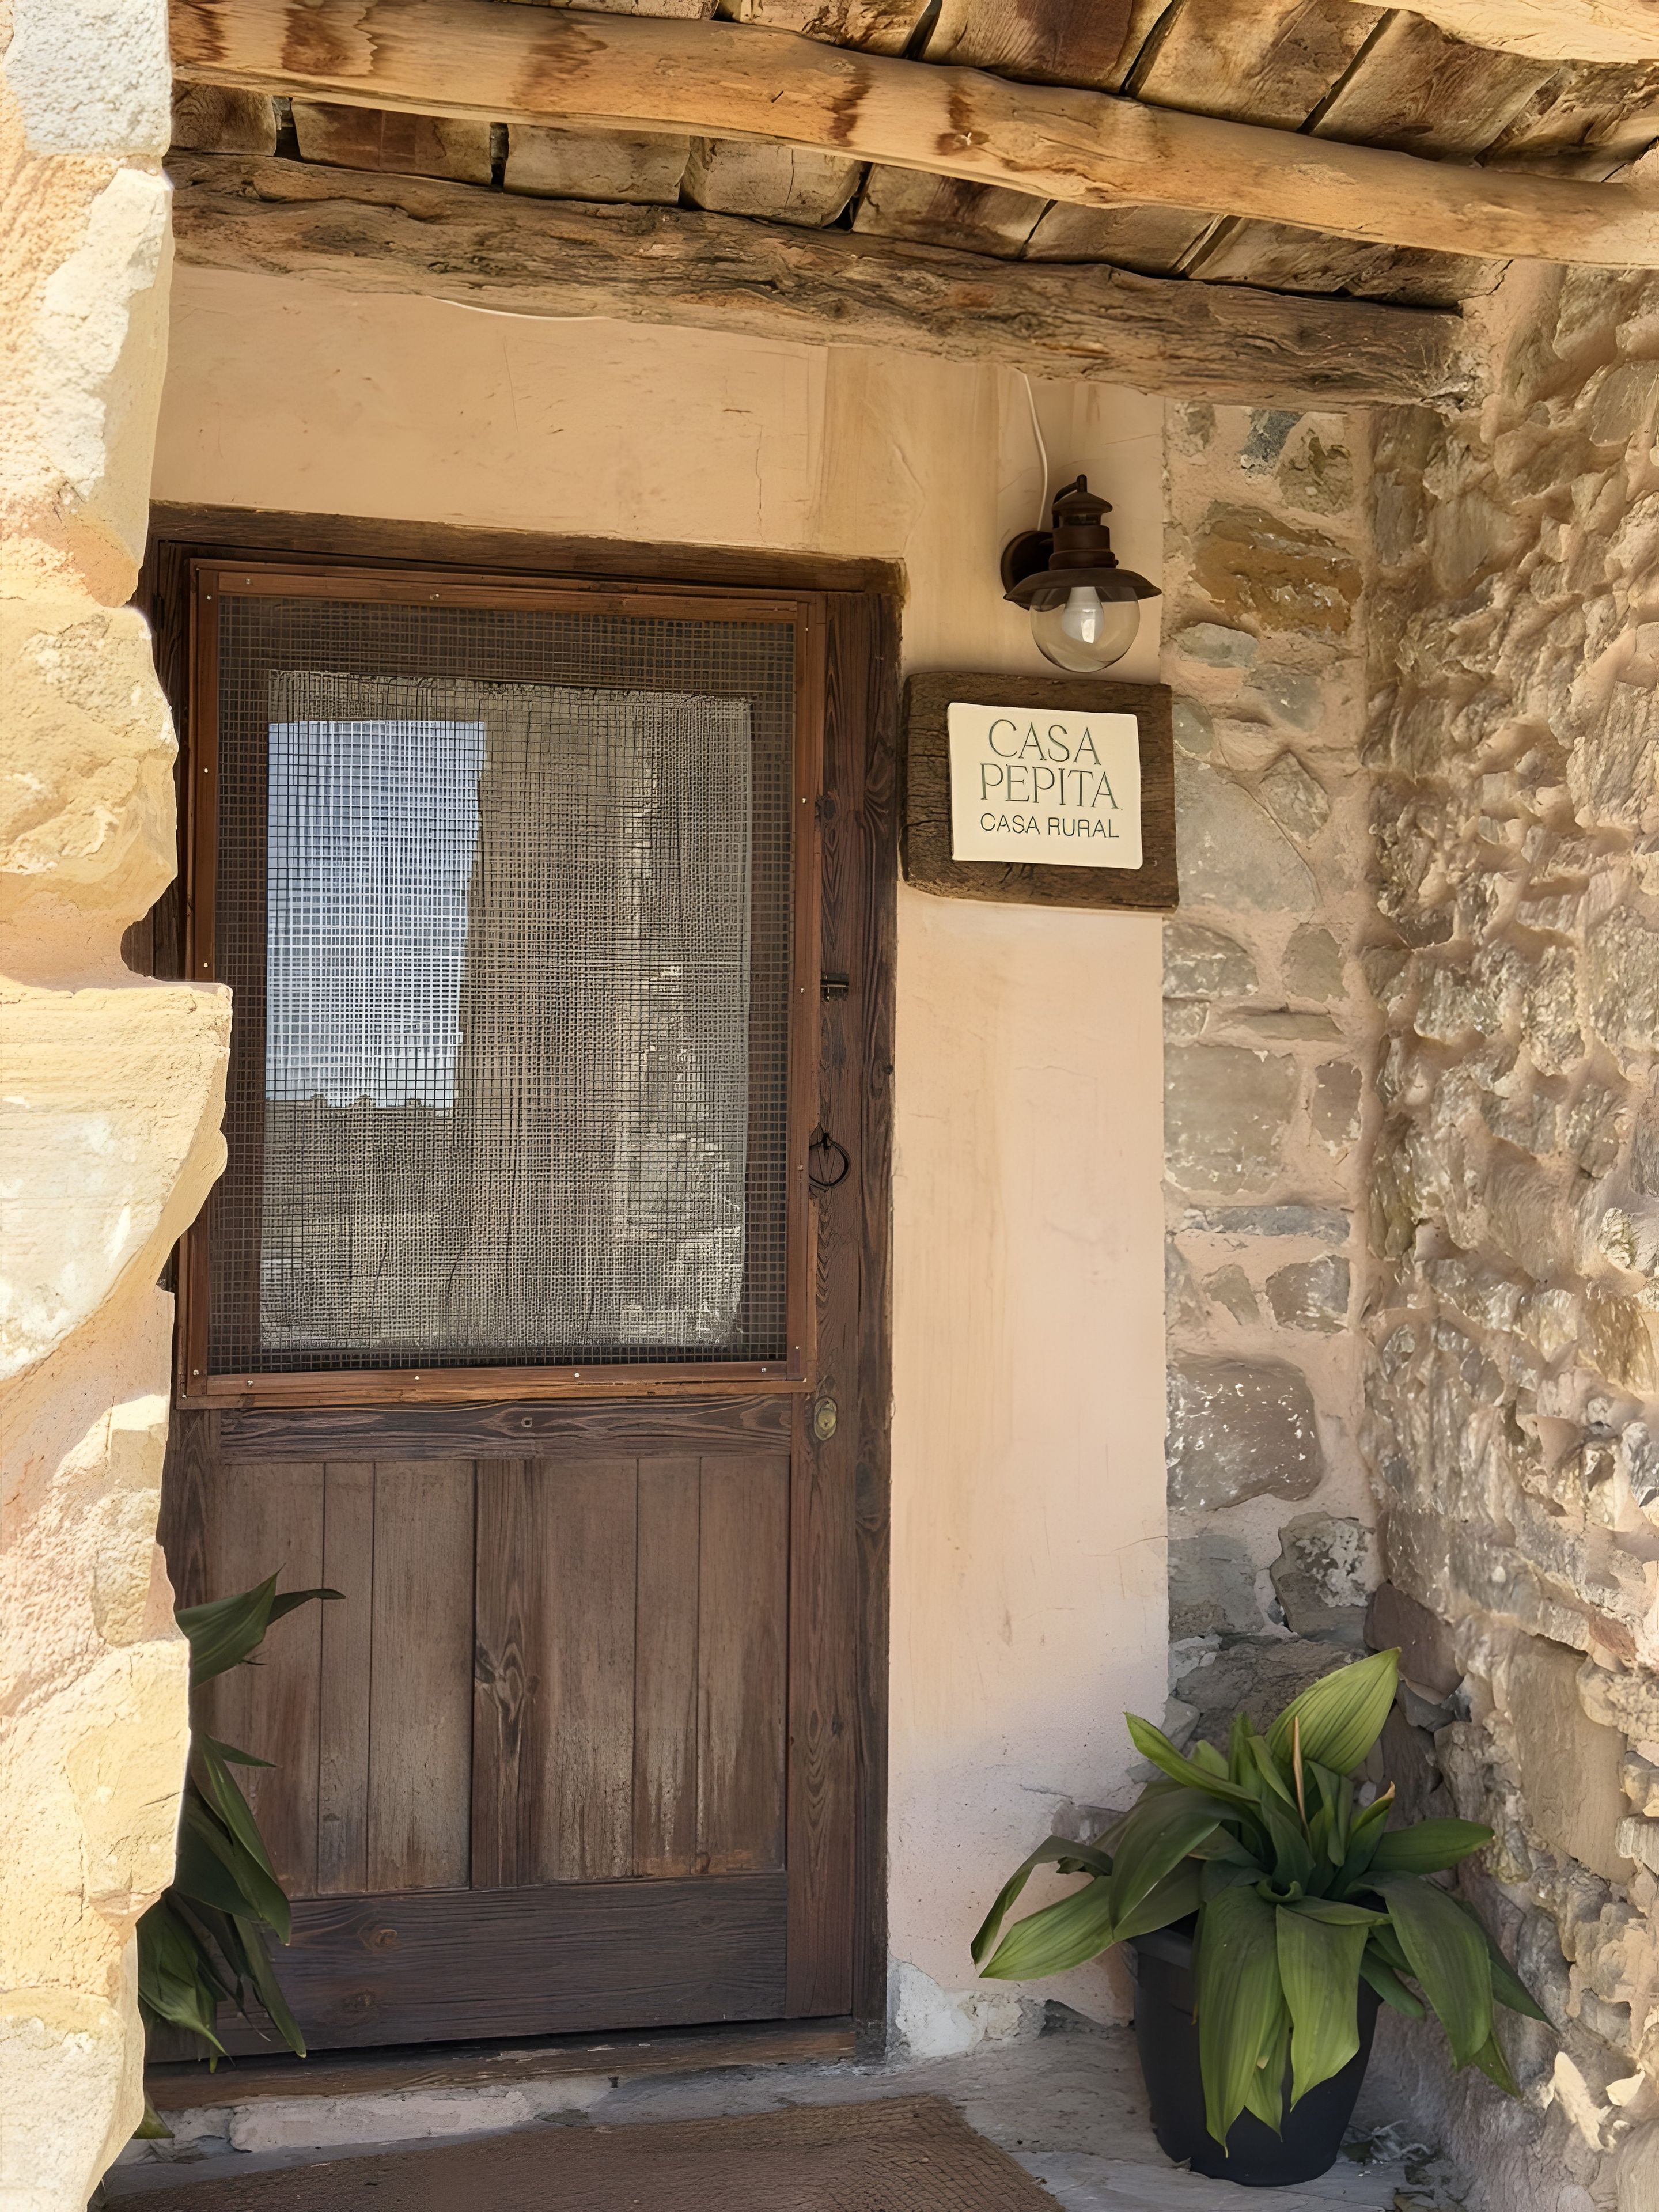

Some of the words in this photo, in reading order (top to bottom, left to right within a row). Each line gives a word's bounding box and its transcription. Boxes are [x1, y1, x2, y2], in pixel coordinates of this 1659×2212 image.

[988, 719, 1101, 766] CASA
[979, 763, 1119, 810] PEPITA
[980, 813, 1040, 835] CASA
[1048, 817, 1119, 838] RURAL
